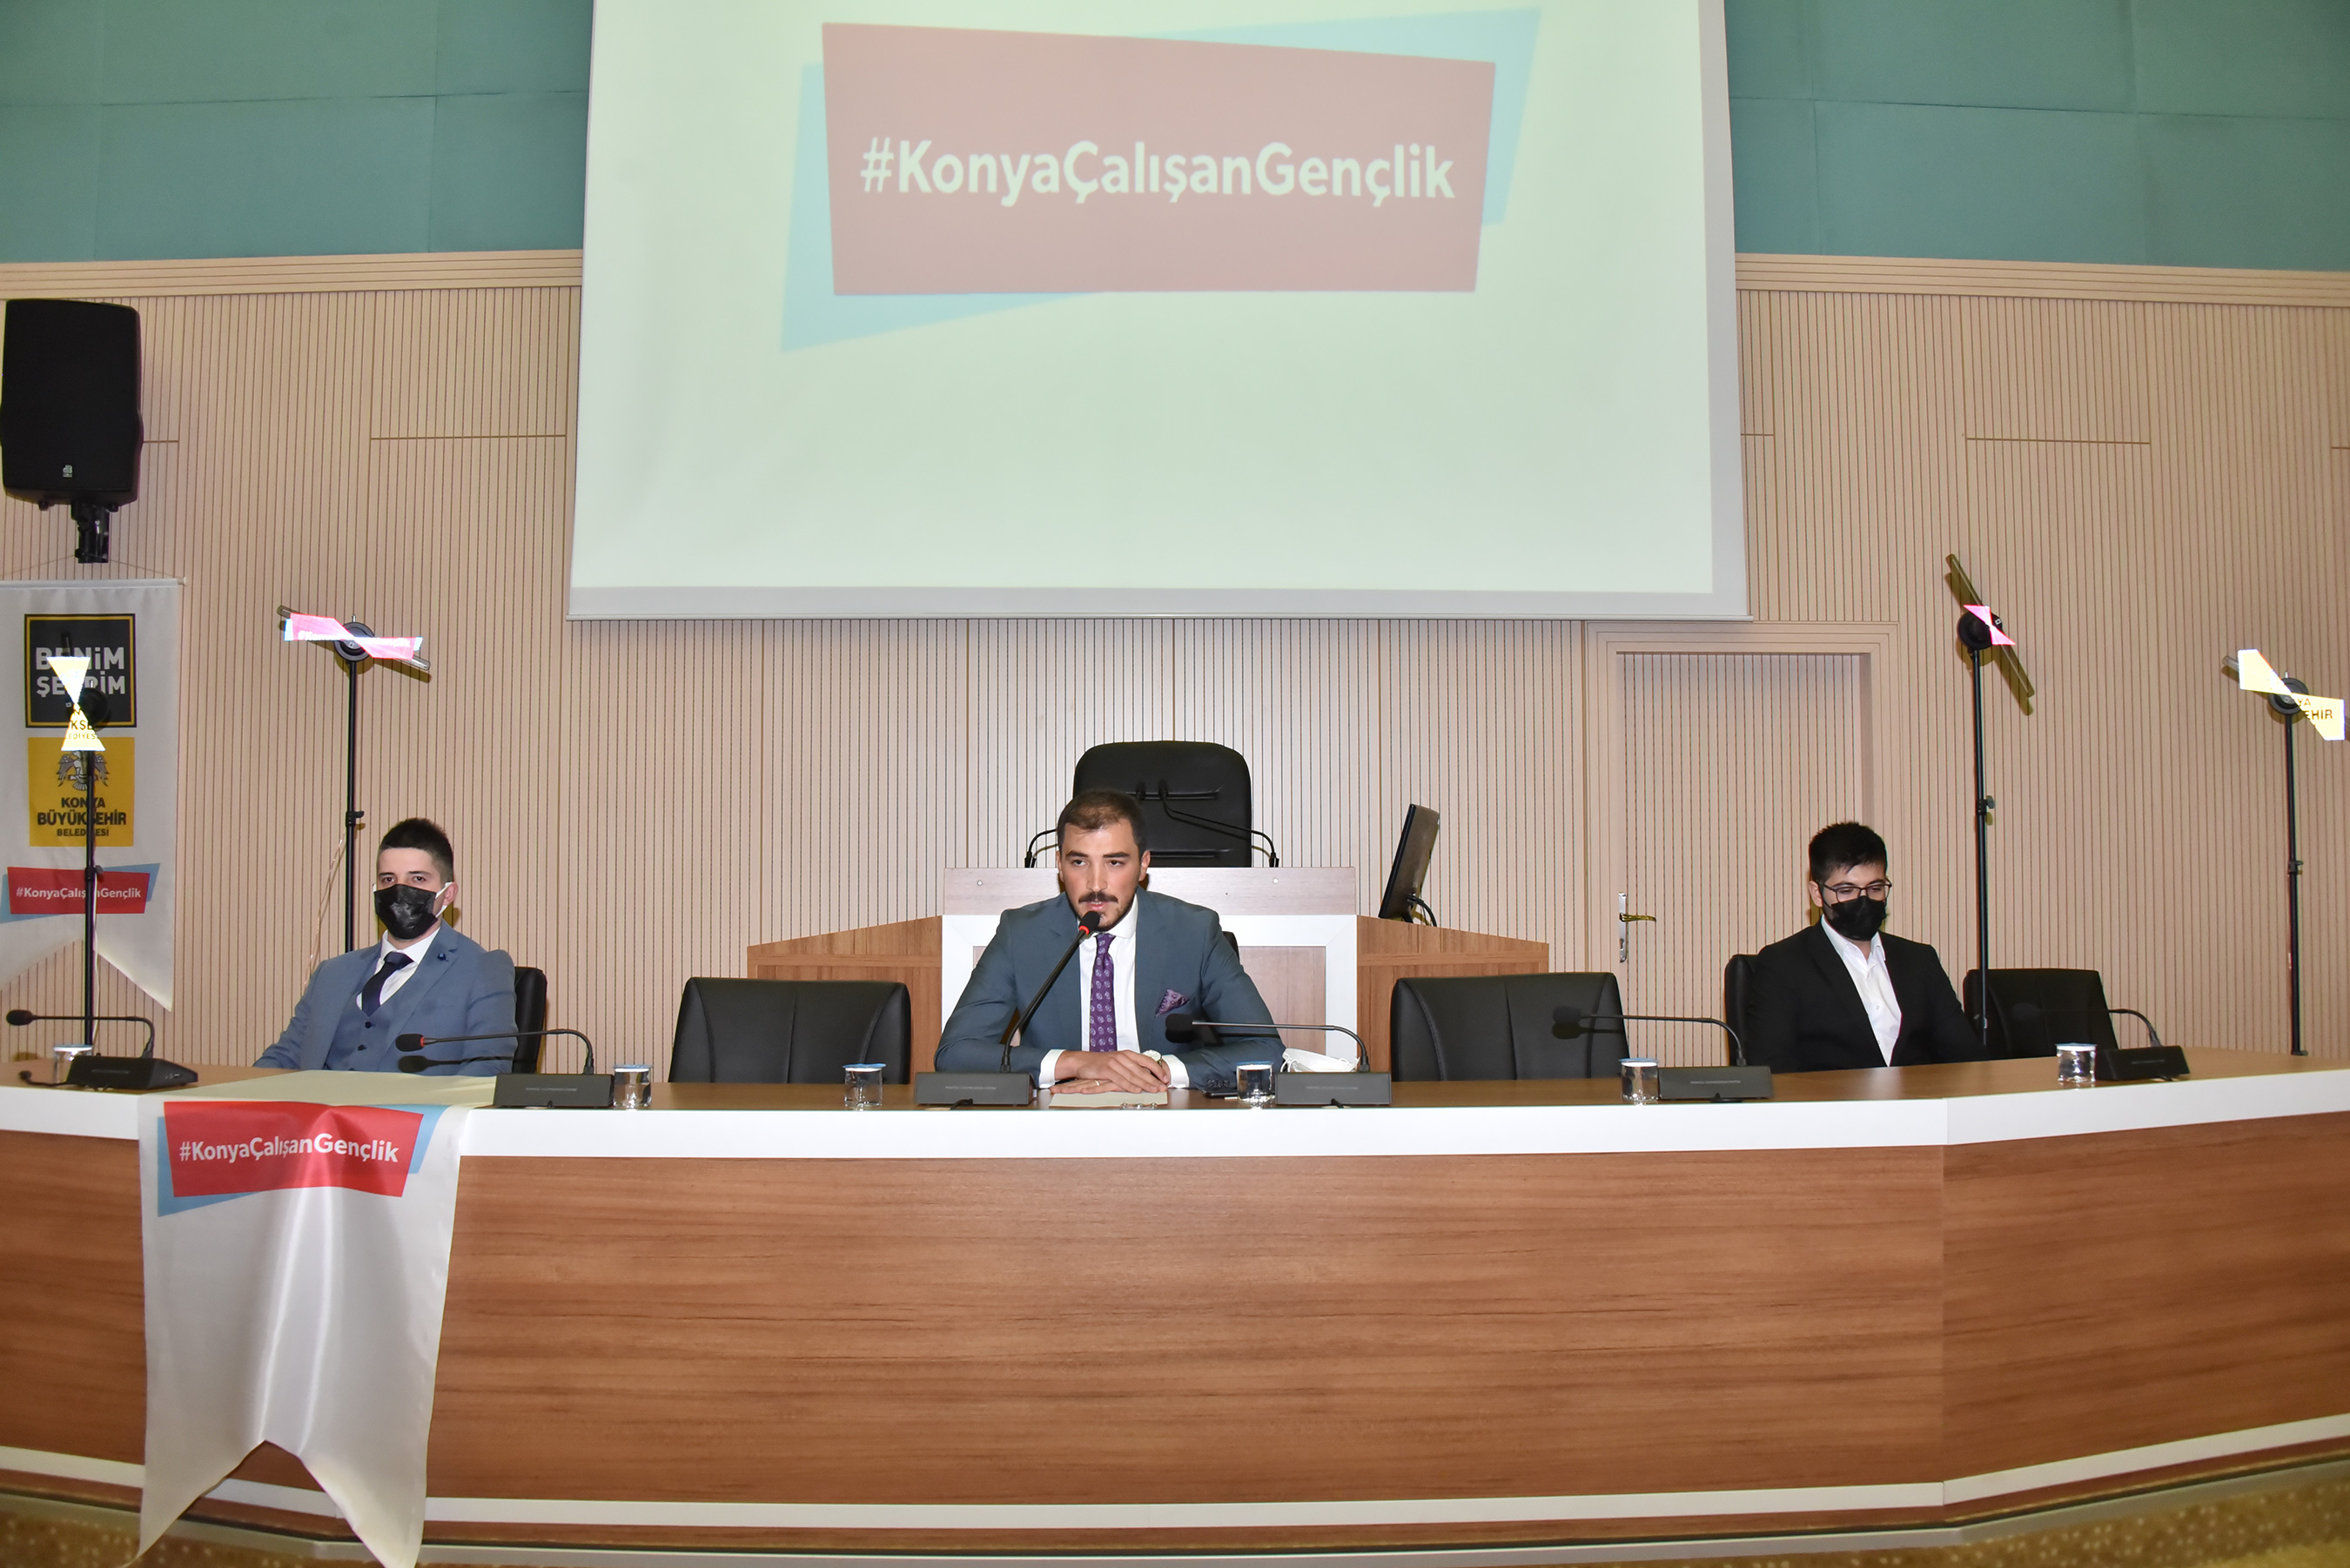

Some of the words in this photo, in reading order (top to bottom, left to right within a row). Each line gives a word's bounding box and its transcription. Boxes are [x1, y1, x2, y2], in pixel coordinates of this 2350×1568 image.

[860, 137, 1455, 207] #KonyaÇalışanGençlik
[37, 809, 126, 826] BÜYÜKEHİR
[57, 827, 110, 837] BELEDESİ
[179, 1133, 399, 1163] #KonyaÇalışanGençlik
